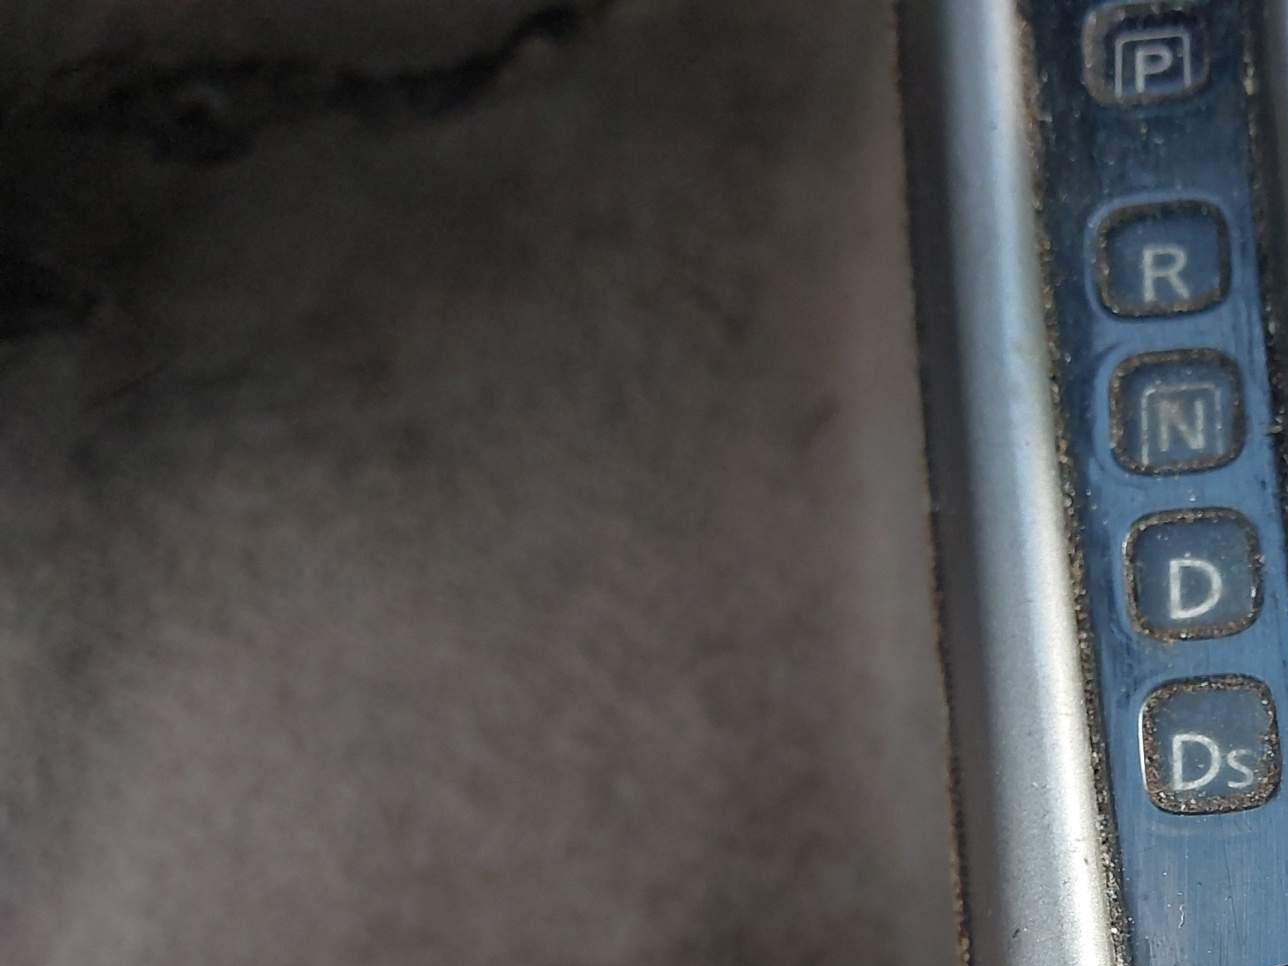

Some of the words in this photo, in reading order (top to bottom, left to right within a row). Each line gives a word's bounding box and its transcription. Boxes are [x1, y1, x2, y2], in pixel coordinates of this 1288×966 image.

[1133, 44, 1174, 94] P
[1141, 243, 1190, 302] R
[1158, 397, 1205, 452] N
[1168, 558, 1223, 620] D
[1171, 733, 1255, 792] Ds
